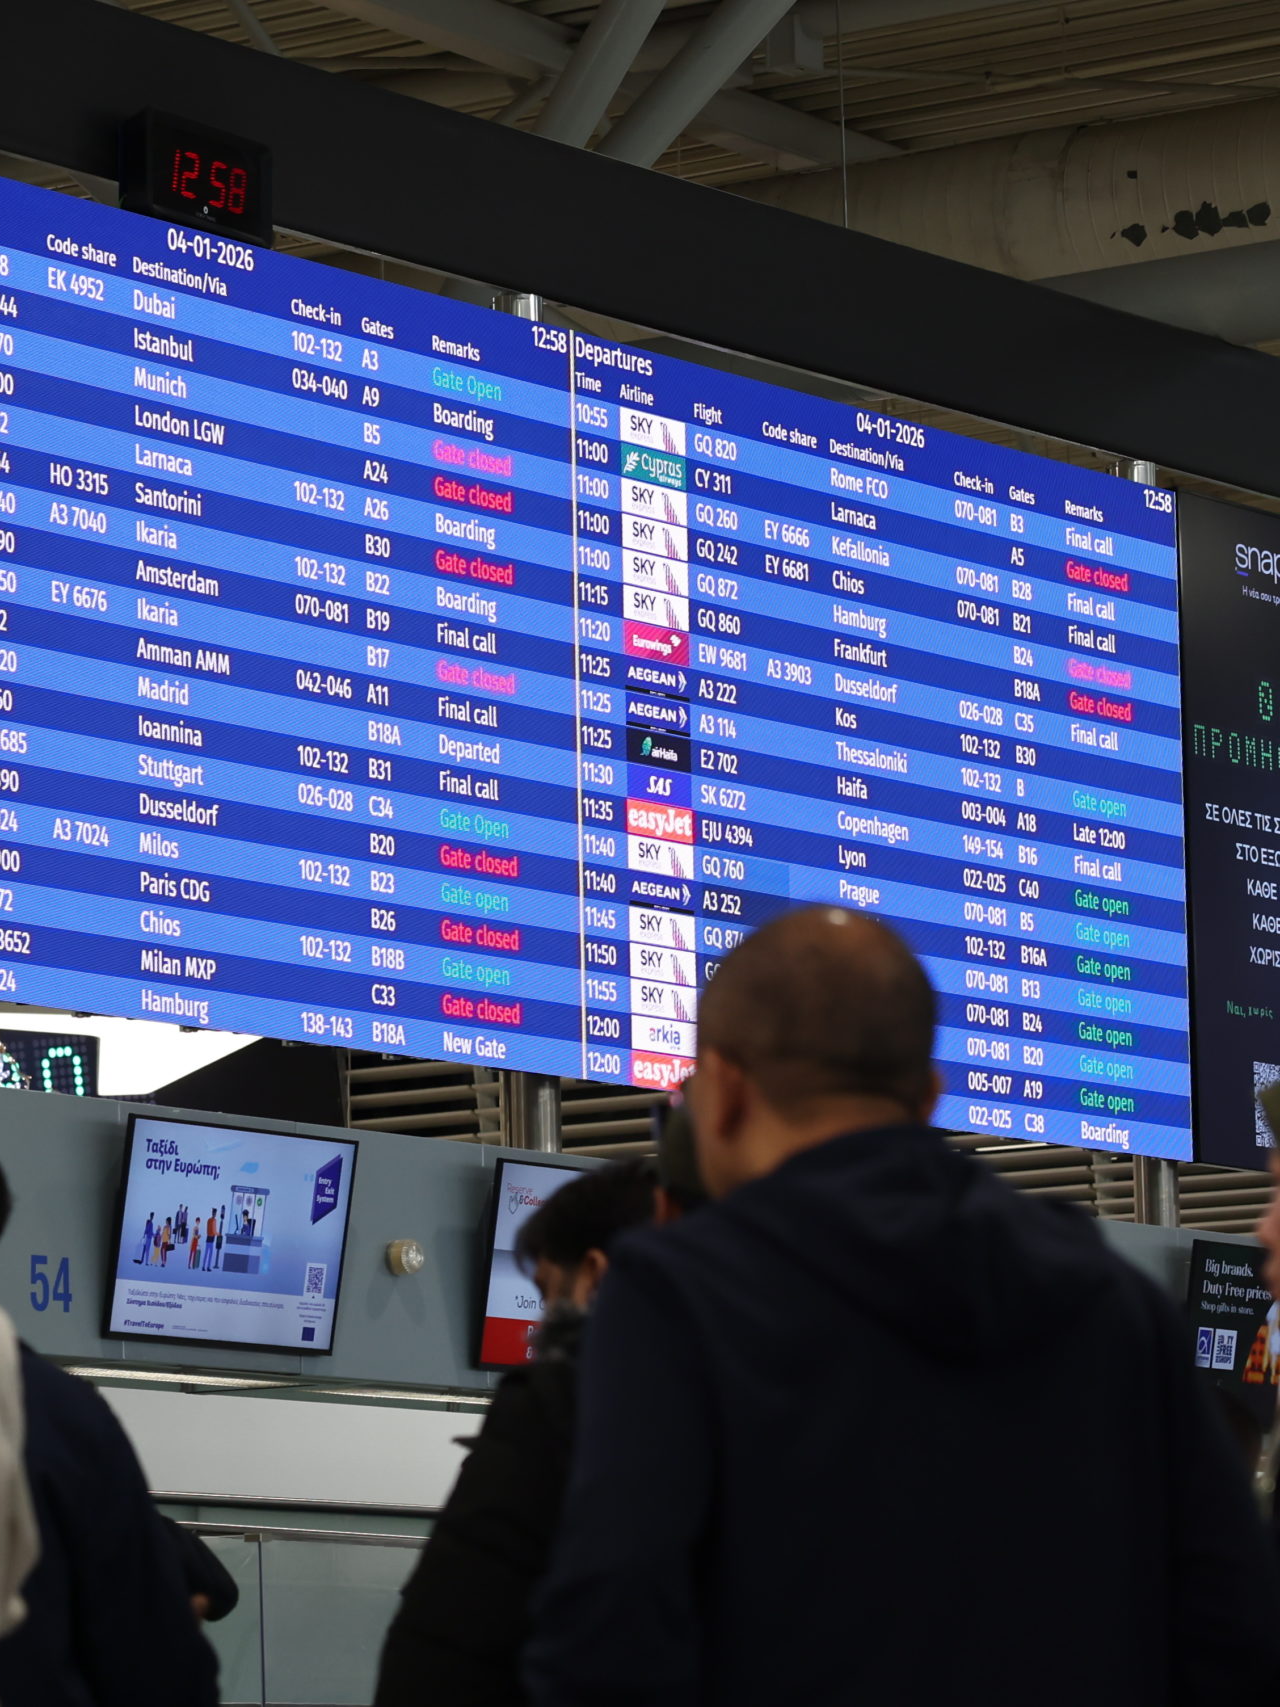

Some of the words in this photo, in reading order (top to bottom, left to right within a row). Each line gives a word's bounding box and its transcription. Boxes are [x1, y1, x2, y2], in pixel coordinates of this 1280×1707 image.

[47, 234, 79, 259] Code
[82, 243, 117, 267] share
[168, 228, 253, 271] 04-01-2026
[133, 257, 227, 296] Destination/Via
[134, 289, 175, 319] Dubai
[291, 299, 341, 325] Check-in
[362, 317, 393, 339] Gates
[531, 326, 567, 355] 12:58
[134, 328, 193, 361] Istanbul
[432, 335, 480, 361] Remarks
[575, 336, 653, 376] Departures
[134, 366, 187, 398] Munich
[293, 368, 347, 399] 034-040
[575, 370, 602, 394] Time
[620, 385, 653, 405] Airline
[135, 405, 189, 436] London
[194, 420, 224, 445] LGW
[434, 403, 493, 441] Boarding
[576, 401, 608, 429] 10:55
[630, 414, 652, 433] SKY
[694, 404, 722, 425] Flight
[857, 413, 924, 448] 04-01-2026
[641, 452, 683, 478] Cyprus
[830, 439, 903, 471] Destination/Via
[954, 472, 993, 493] Check-in
[1009, 486, 1034, 504] Gates
[136, 483, 201, 516] Santorini
[1065, 500, 1103, 522] Remarks
[1144, 492, 1172, 512] 12:58
[832, 502, 876, 529] Larnaca
[832, 536, 890, 567] Kefallonia
[580, 652, 611, 678] 11:25
[835, 639, 887, 667] Frankfurt
[139, 716, 202, 746] Ioannina
[836, 708, 856, 728] Kos
[439, 734, 500, 764] Departed
[1194, 724, 1280, 771] ΠΡΟΜΗ
[138, 754, 204, 788] Stuttgart
[647, 776, 672, 796] SAS
[838, 776, 867, 799] Haifa
[628, 808, 692, 836] easyJet
[837, 810, 909, 844] Copenhagen
[1205, 803, 1220, 822] ΣΕ
[1222, 807, 1253, 829] ΟΛΕΣ
[1254, 813, 1271, 833] ΤΙΣ
[839, 845, 866, 869] Lyon
[1235, 843, 1259, 863] ΣΤΟ
[839, 879, 880, 907] Prague
[1247, 878, 1278, 901] ΚΑΘΕ
[1021, 946, 1047, 966] B16A
[142, 989, 209, 1025] Hamburg
[649, 1025, 681, 1045] arkia
[145, 1138, 179, 1157] Ταξίδι
[1081, 1121, 1130, 1150] Boarding
[145, 1158, 172, 1175] στην
[174, 1158, 220, 1181] Ευρώπη;
[1205, 1258, 1220, 1277] Big
[1221, 1260, 1254, 1277] brands.
[30, 1255, 72, 1313] 54
[1202, 1279, 1224, 1299] Duty
[1224, 1282, 1245, 1297] Free
